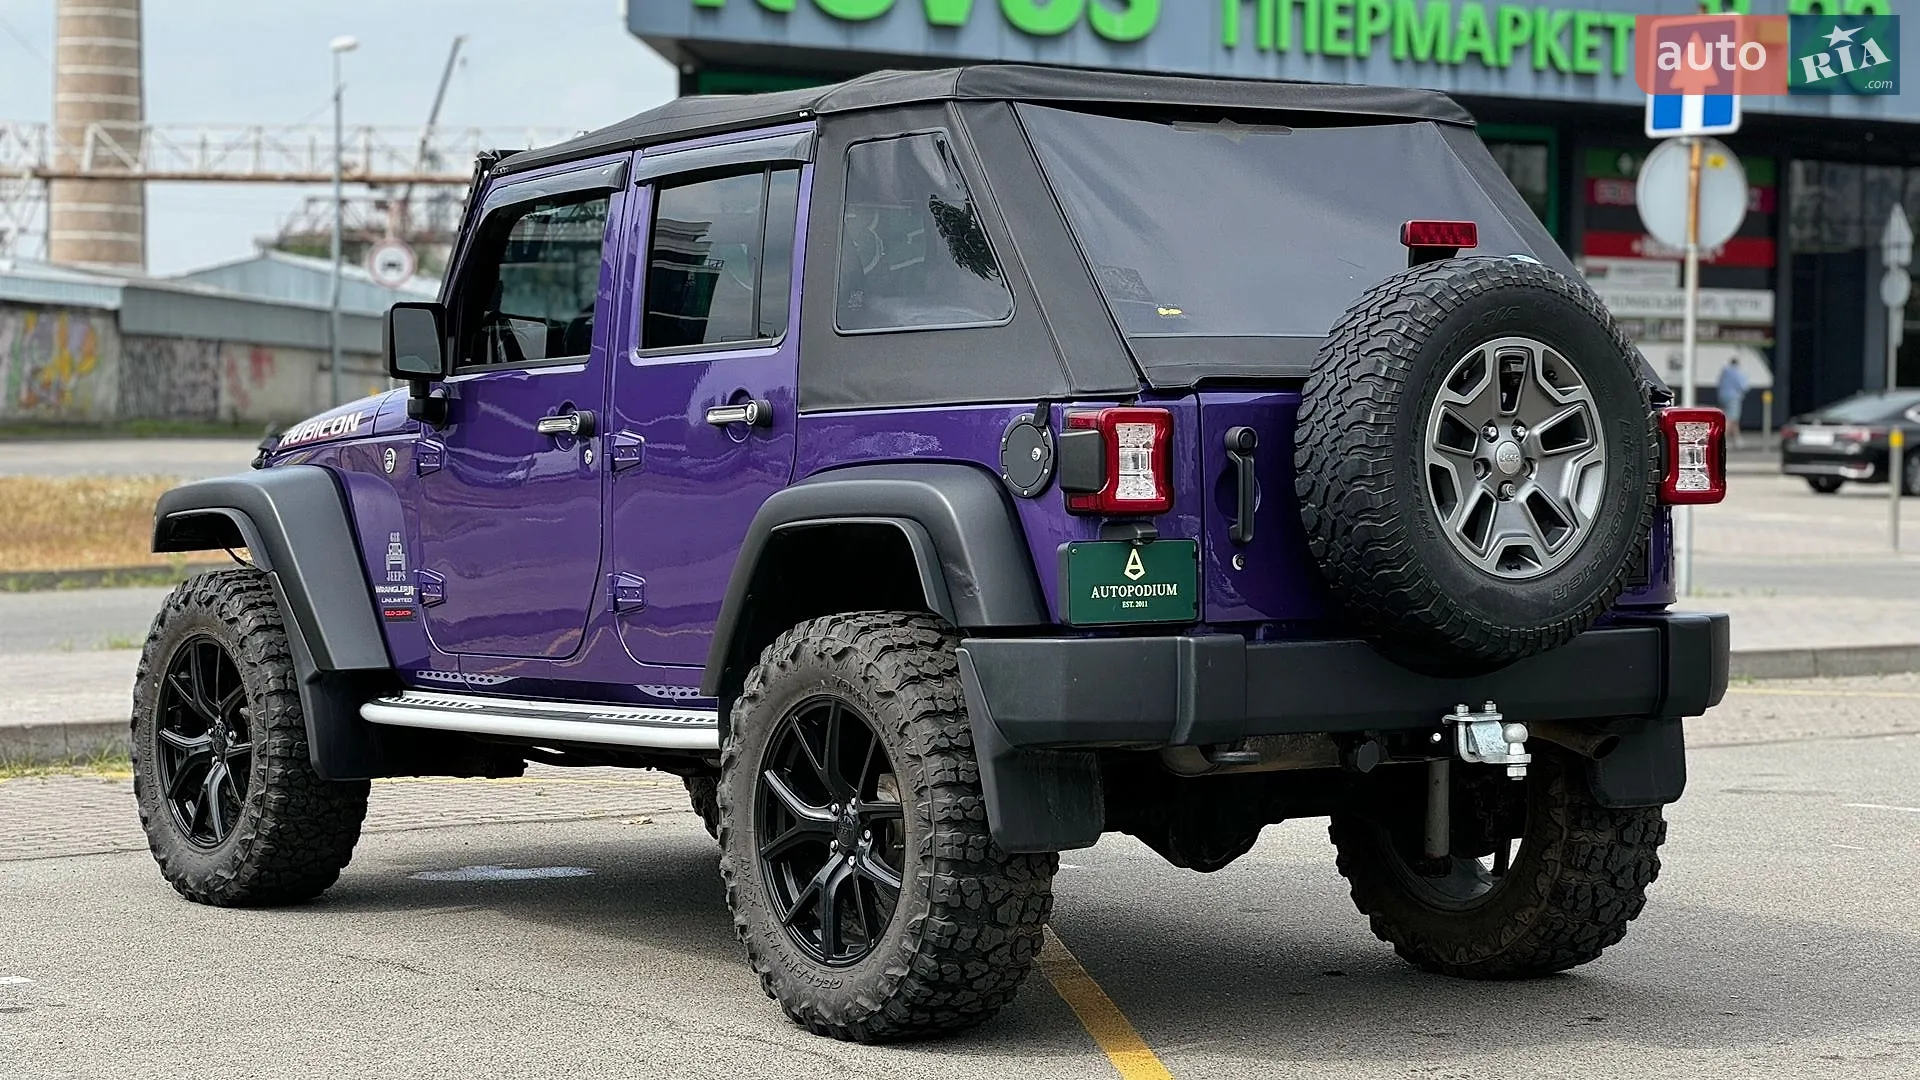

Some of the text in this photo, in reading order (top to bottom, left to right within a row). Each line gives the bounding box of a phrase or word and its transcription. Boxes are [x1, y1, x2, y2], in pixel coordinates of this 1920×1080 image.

[279, 411, 363, 447] RUBICON
[386, 570, 406, 582] JEEPS
[1091, 583, 1178, 599] AUTOPODIUM
[1122, 600, 1148, 608] EST. 2011
